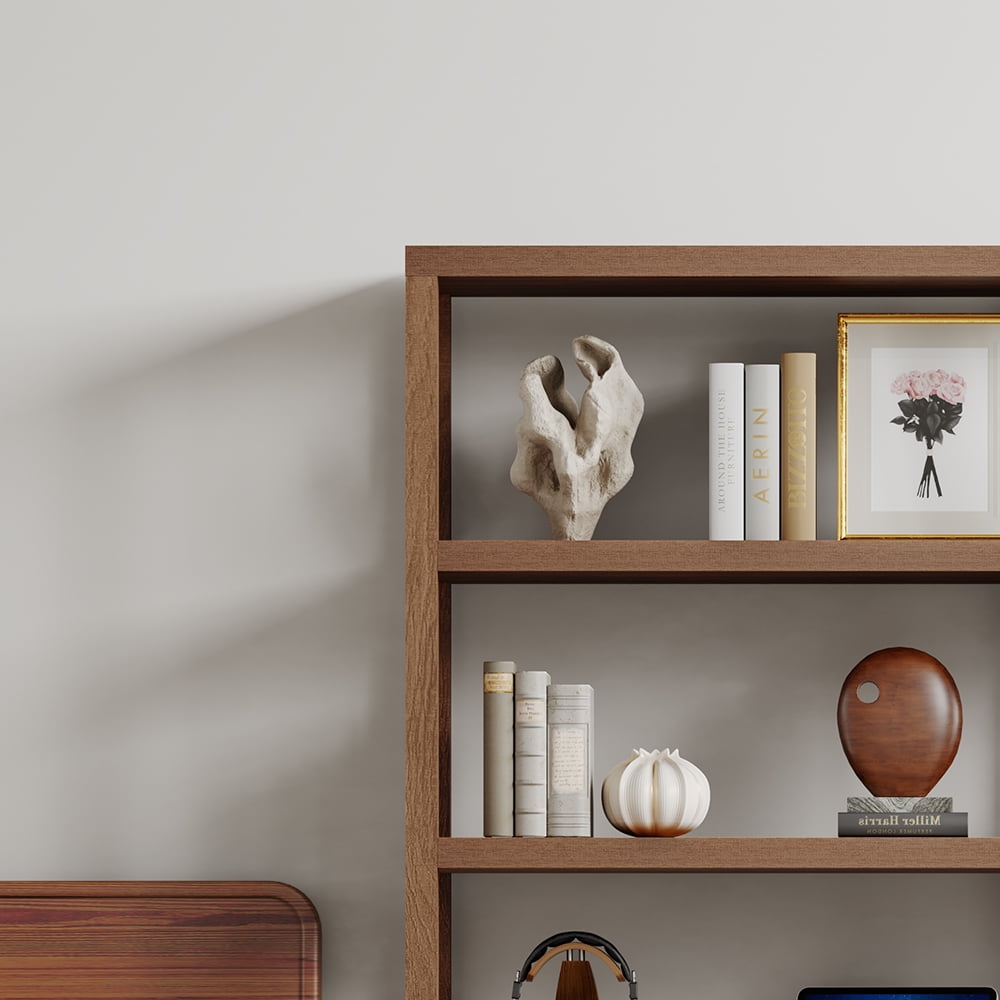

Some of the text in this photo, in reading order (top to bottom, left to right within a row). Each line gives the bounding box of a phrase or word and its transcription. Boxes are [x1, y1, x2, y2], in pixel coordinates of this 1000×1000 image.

[717, 434, 726, 458] THE
[752, 408, 770, 504] AERIN
[717, 462, 726, 512] AROUND
